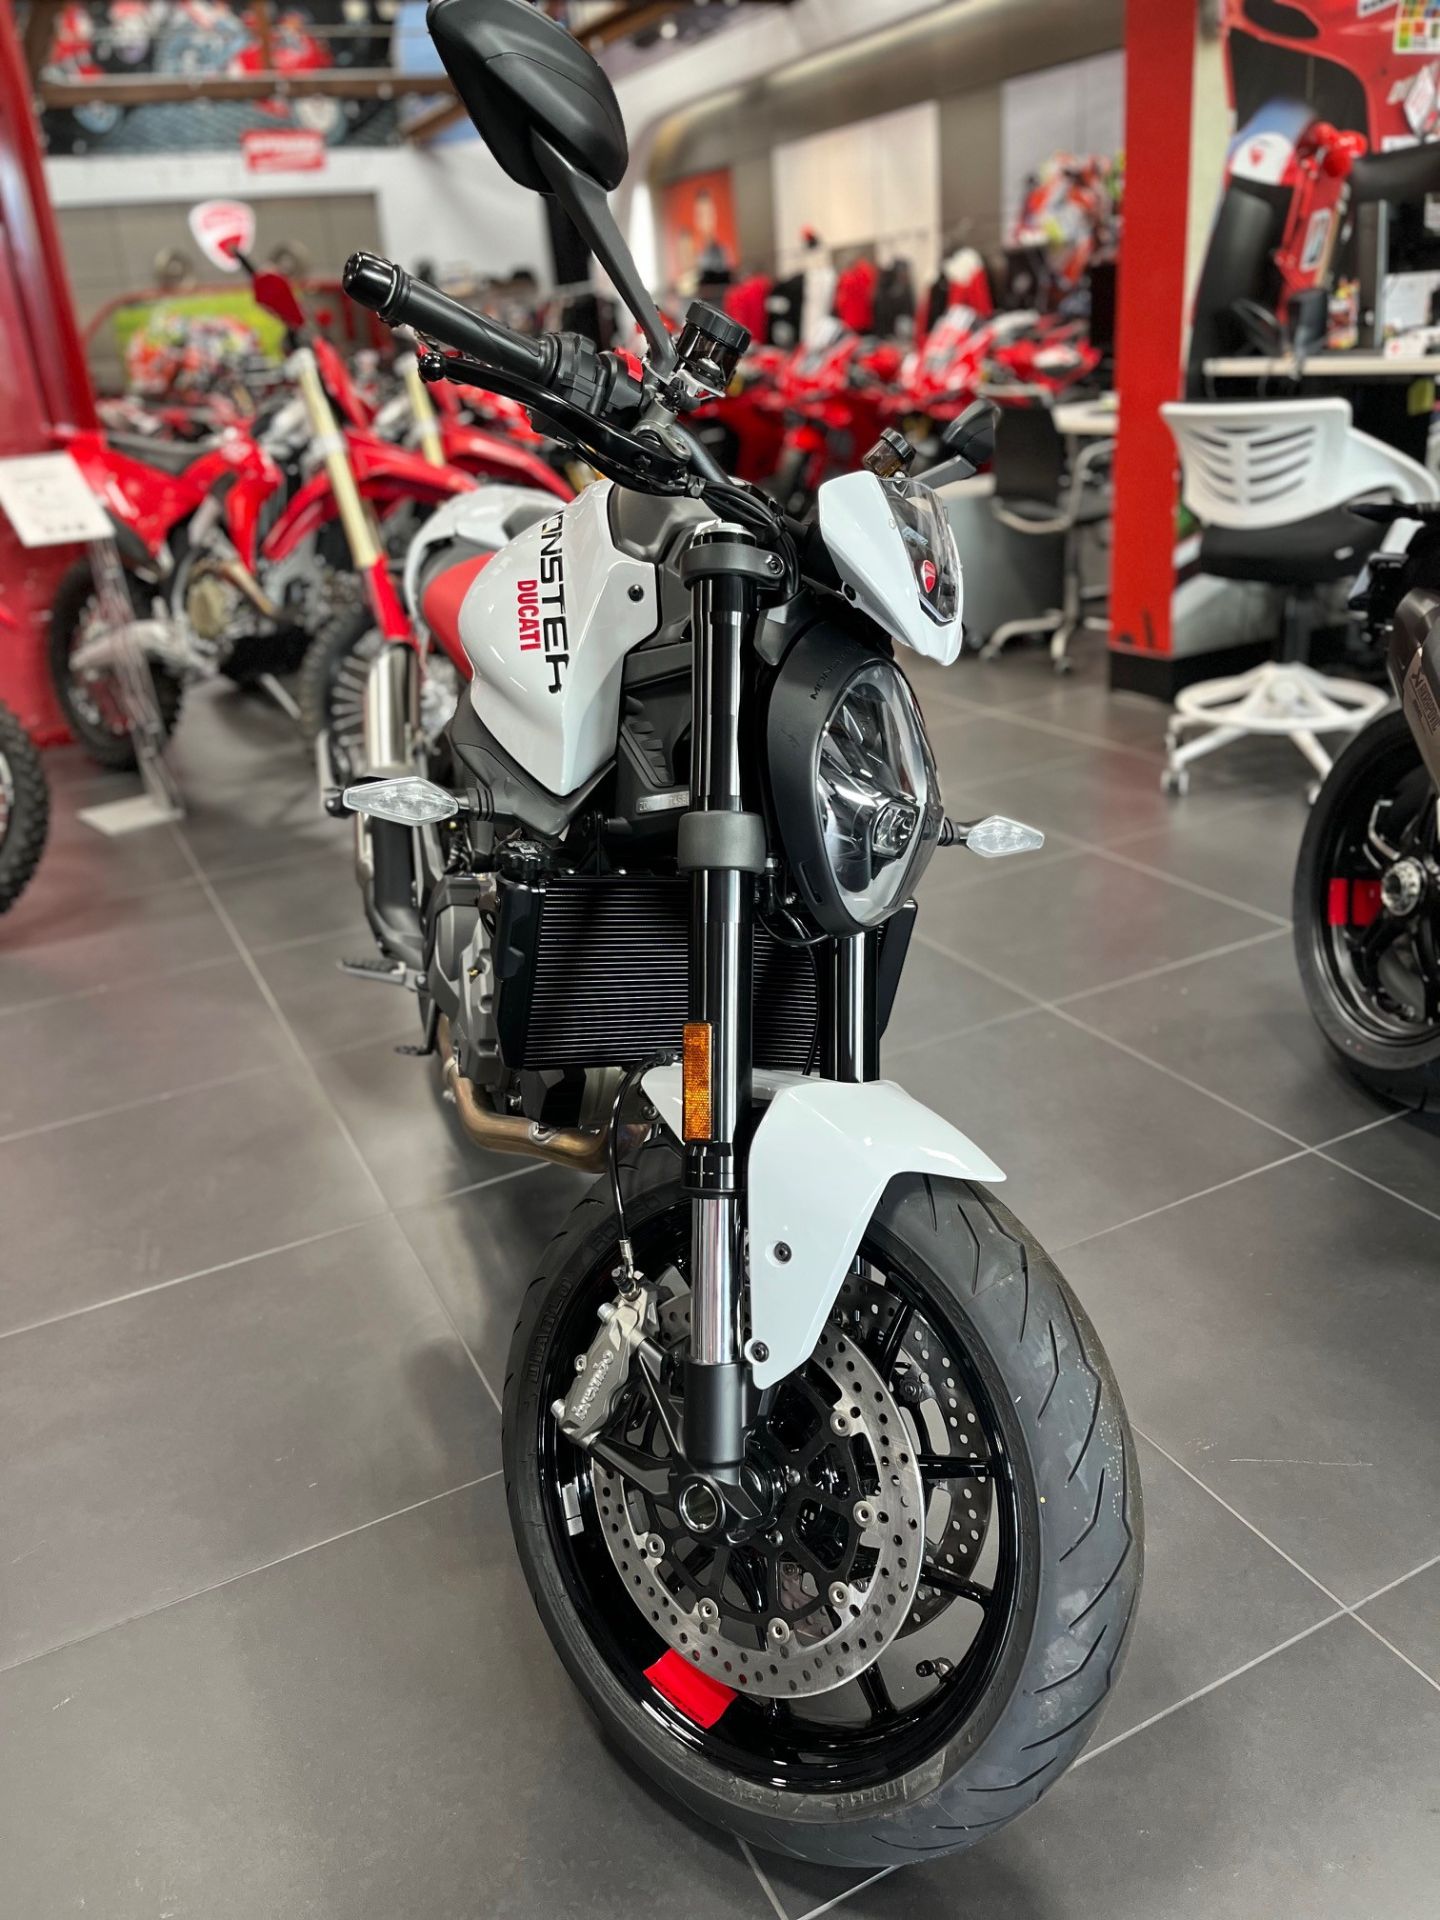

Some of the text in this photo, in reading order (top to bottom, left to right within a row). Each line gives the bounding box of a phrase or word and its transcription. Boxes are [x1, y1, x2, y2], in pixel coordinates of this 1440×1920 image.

[517, 579, 541, 651] DUCATI
[540, 510, 570, 694] ONSTER
[571, 1349, 614, 1421] brembo
